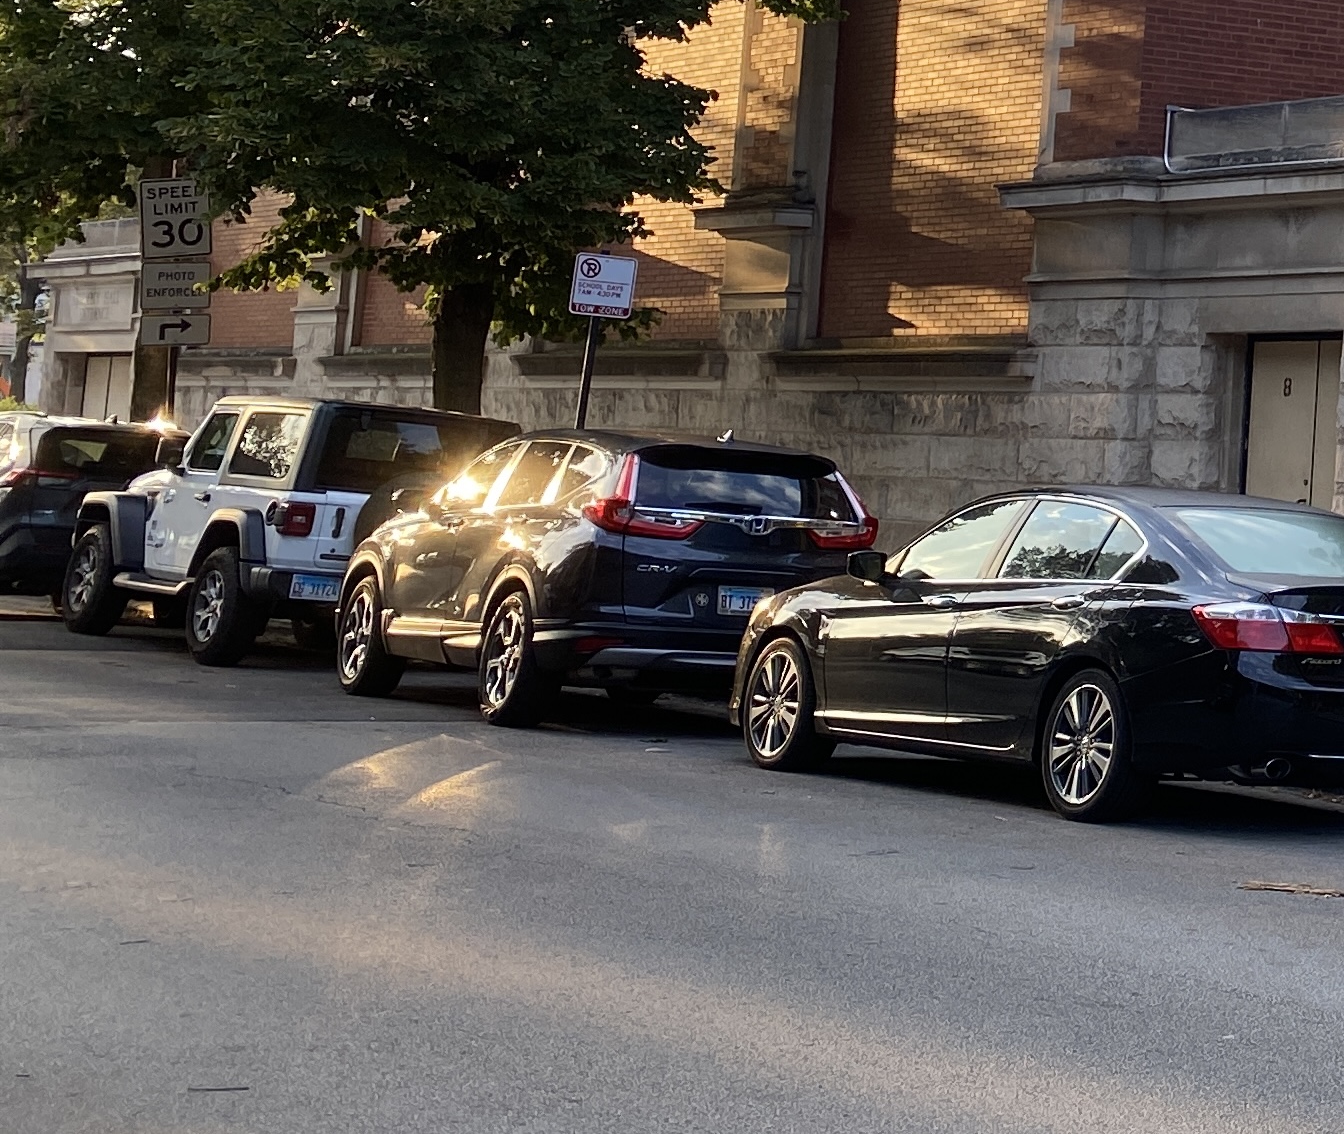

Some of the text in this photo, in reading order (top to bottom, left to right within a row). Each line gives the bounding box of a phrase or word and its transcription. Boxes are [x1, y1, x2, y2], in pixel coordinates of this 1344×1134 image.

[146, 185, 205, 200] SPEED
[153, 201, 198, 216] LIMIT
[151, 218, 204, 248] 30
[158, 271, 195, 282] PHOTO
[578, 282, 603, 291] SCHOOL
[575, 304, 625, 316] TOW ZONE
[1284, 377, 1292, 397] 8
[637, 565, 678, 573] CR-V
[721, 594, 760, 609] BT 375
